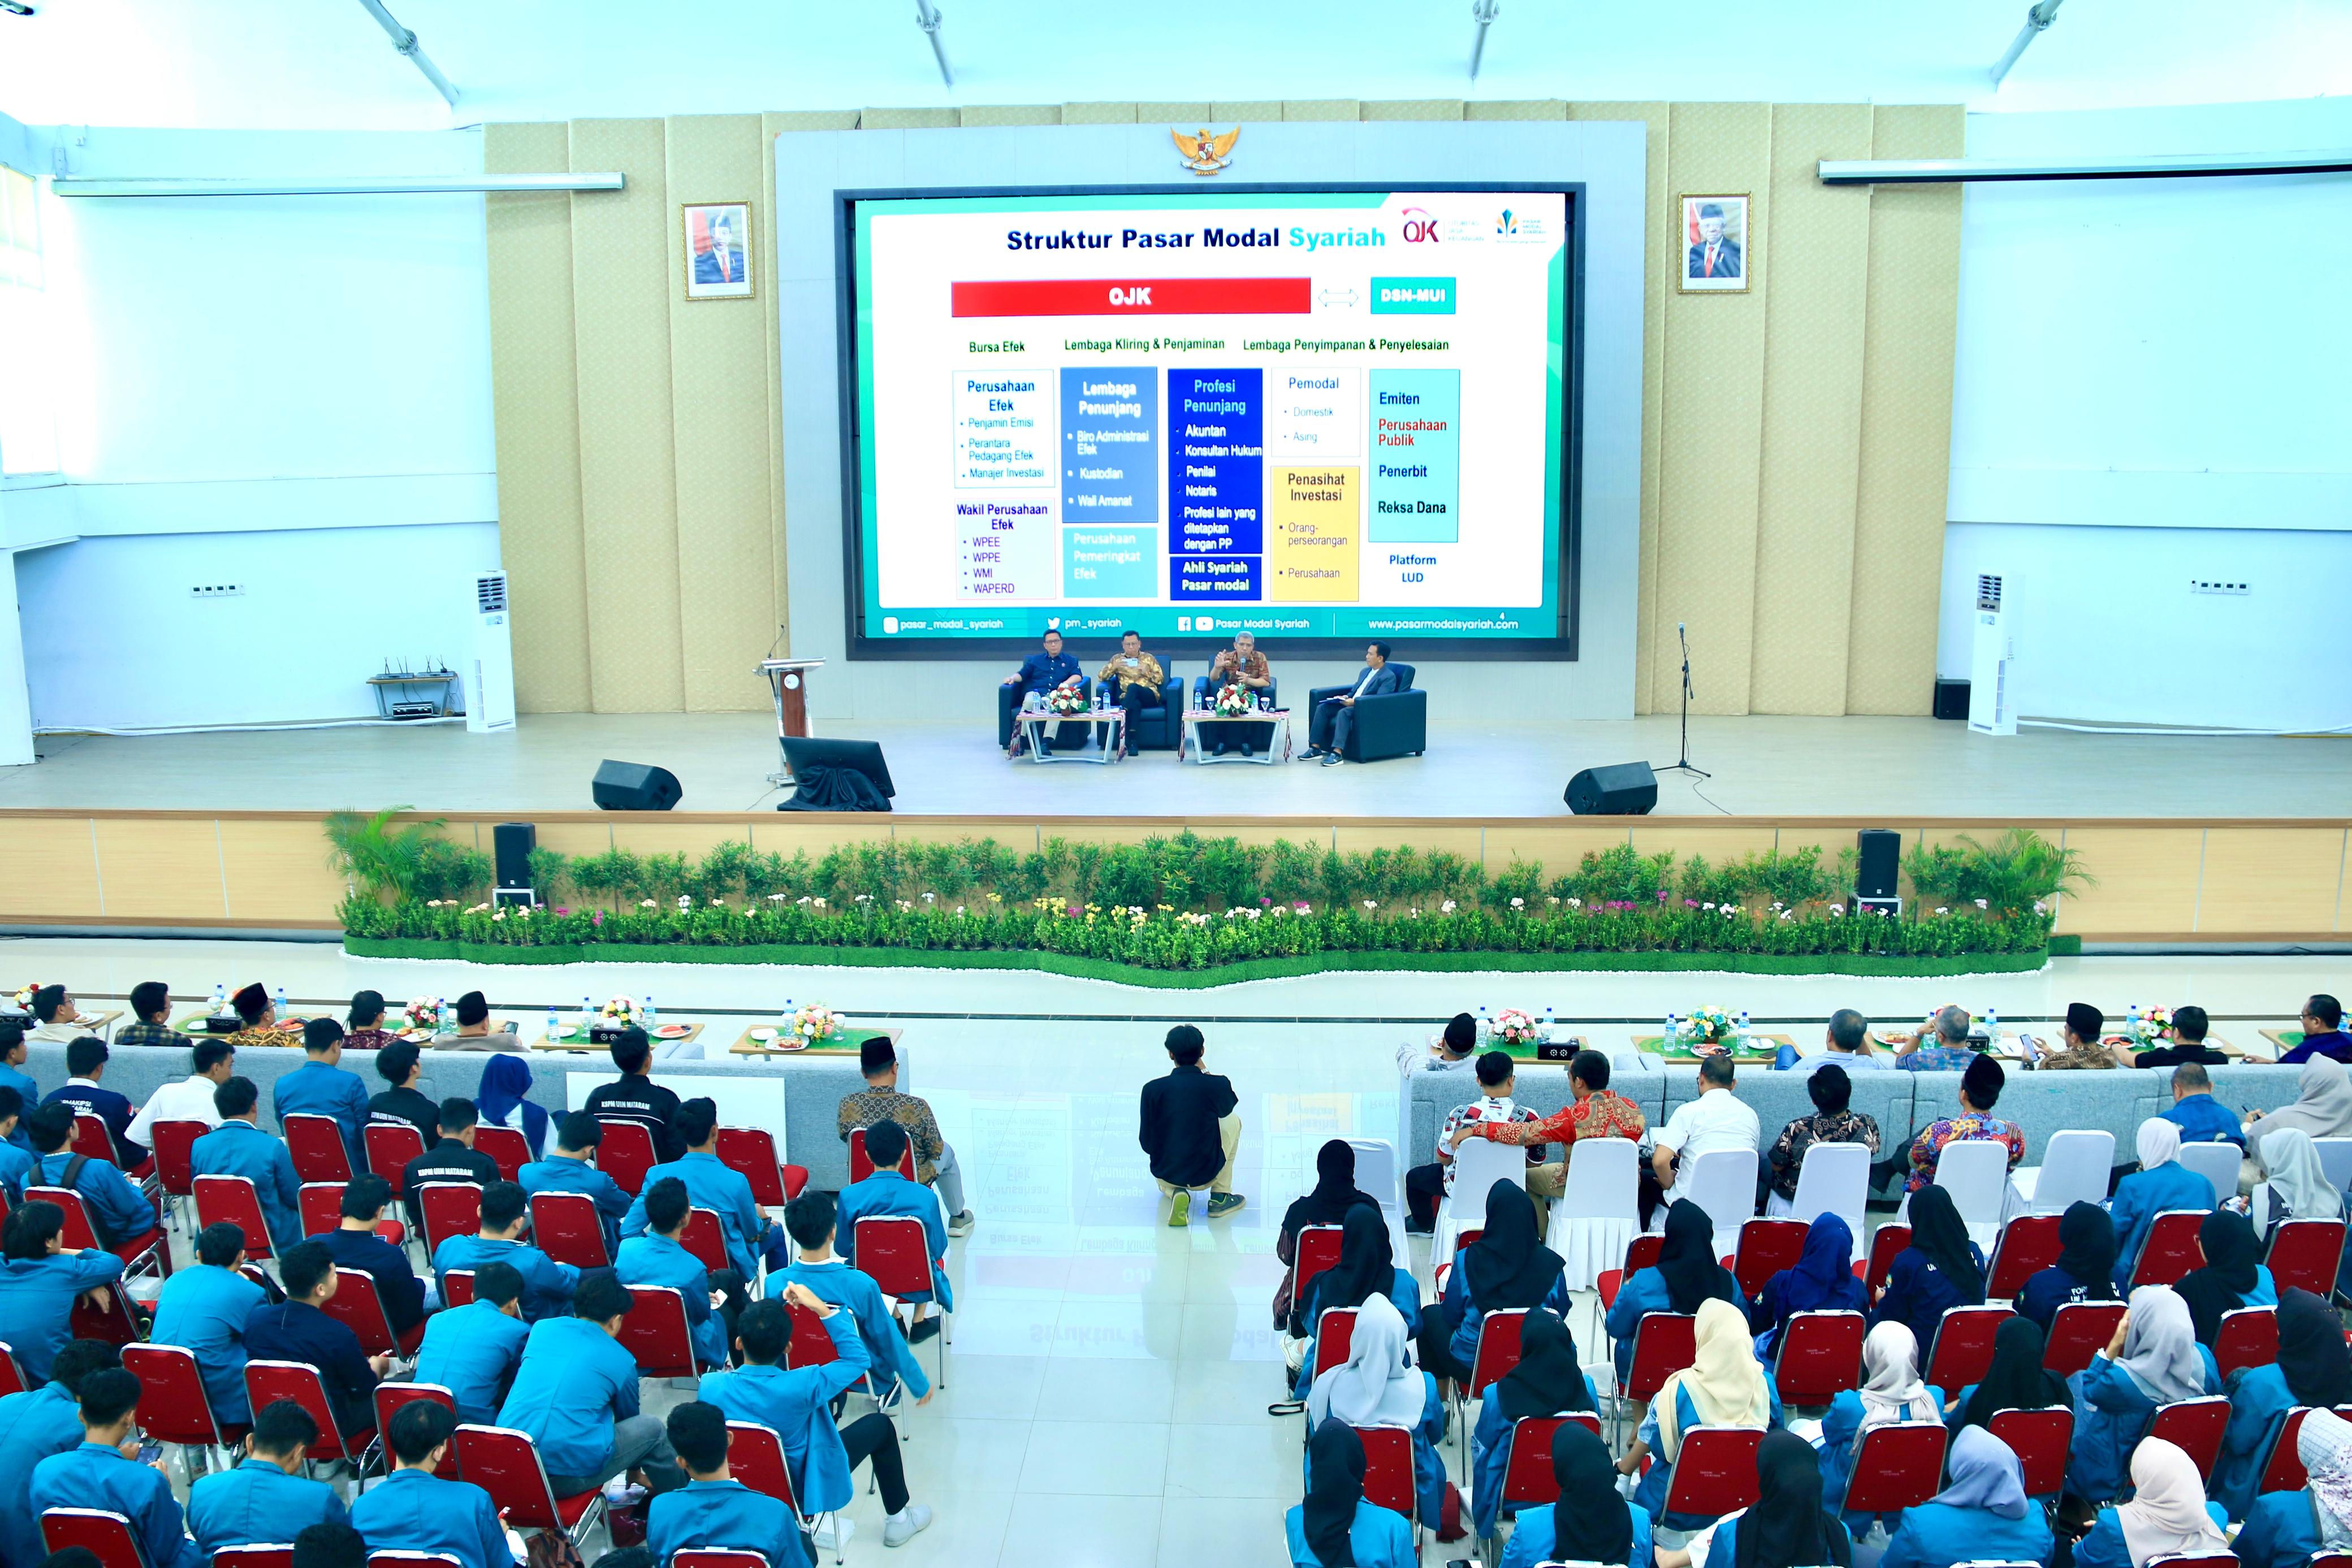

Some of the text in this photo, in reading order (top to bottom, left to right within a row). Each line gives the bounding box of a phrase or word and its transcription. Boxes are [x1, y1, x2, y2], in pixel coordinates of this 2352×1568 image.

[1008, 227, 1385, 252] Struktur Pasar Modal Syariah
[1109, 287, 1152, 306] OJK
[1381, 288, 1446, 303] DSN-MUI
[970, 340, 1024, 353] Bursa Efek
[1065, 337, 1224, 352] Lembaga Kliring & Penjaminan
[1243, 339, 1449, 354] Lembaga Penyimpanan & Penyelesaian
[968, 380, 1034, 392] Perusahaan
[1195, 379, 1235, 392] Profesi
[1289, 377, 1339, 389] Pemodal
[1083, 382, 1136, 399] Lembaga
[1380, 392, 1420, 405] Emiten
[989, 399, 1014, 411] Efek
[1079, 401, 1141, 418] Penunjang
[1184, 399, 1246, 415] Penunjang
[1294, 407, 1333, 417] Domestik
[969, 417, 1034, 430] Penjamin Emisi
[1378, 418, 1447, 431] Perusahaan
[1077, 430, 1149, 442] Biro Administrasi
[1185, 425, 1226, 437] Akuntan
[969, 439, 1010, 448] Perantara
[1294, 432, 1317, 443] Asing
[1378, 434, 1414, 446] Publik
[1078, 443, 1097, 454] Efek
[1185, 444, 1262, 456] Konsultan Hukum
[969, 451, 1034, 462] Pedagang Efek
[970, 467, 1044, 480] Manajer Investasi
[1080, 467, 1123, 479] Kustodian
[1186, 465, 1216, 477] Penilai
[1379, 465, 1427, 477] Penerbit
[1288, 473, 1344, 485] Penasihat
[1186, 485, 1217, 497] Notaris
[1291, 489, 1342, 501] Investasi
[1078, 495, 1132, 506] Wali Amanat
[957, 504, 1048, 515] Wakil Perusahaan
[1378, 501, 1446, 513] Reksa Dana
[1184, 506, 1256, 521] Profesi lain yang
[992, 519, 1014, 530] Efek
[1184, 522, 1229, 536] ditetapkan
[1289, 522, 1318, 535] Orang-
[972, 537, 1000, 547] WPEE
[1073, 533, 1135, 544] Perusahaan
[1289, 536, 1347, 547] perseorangan
[1184, 538, 1233, 552] dengan PP
[973, 553, 1001, 562] WPPE
[1073, 551, 1140, 564] Pemeringkat
[1390, 555, 1436, 565] Platform
[973, 568, 992, 578] WMI
[1074, 568, 1097, 579] Efek
[1182, 561, 1248, 575] Ahli Syariah
[1289, 568, 1340, 578] Perusahaan
[1402, 573, 1424, 582] LUD
[974, 583, 1014, 593] WAPERD
[1182, 579, 1250, 591] Pasar modal
[900, 618, 1003, 630] pasar_modal_syariah
[1065, 618, 1122, 629] pm_syariah
[1216, 618, 1309, 630] Pasar Modal Syariah
[1368, 618, 1519, 631] www.pasarmodalsyariah.com
[626, 1101, 650, 1110] MATARAM
[418, 1168, 433, 1176] KSPM
[445, 1167, 473, 1176] MATARAM
